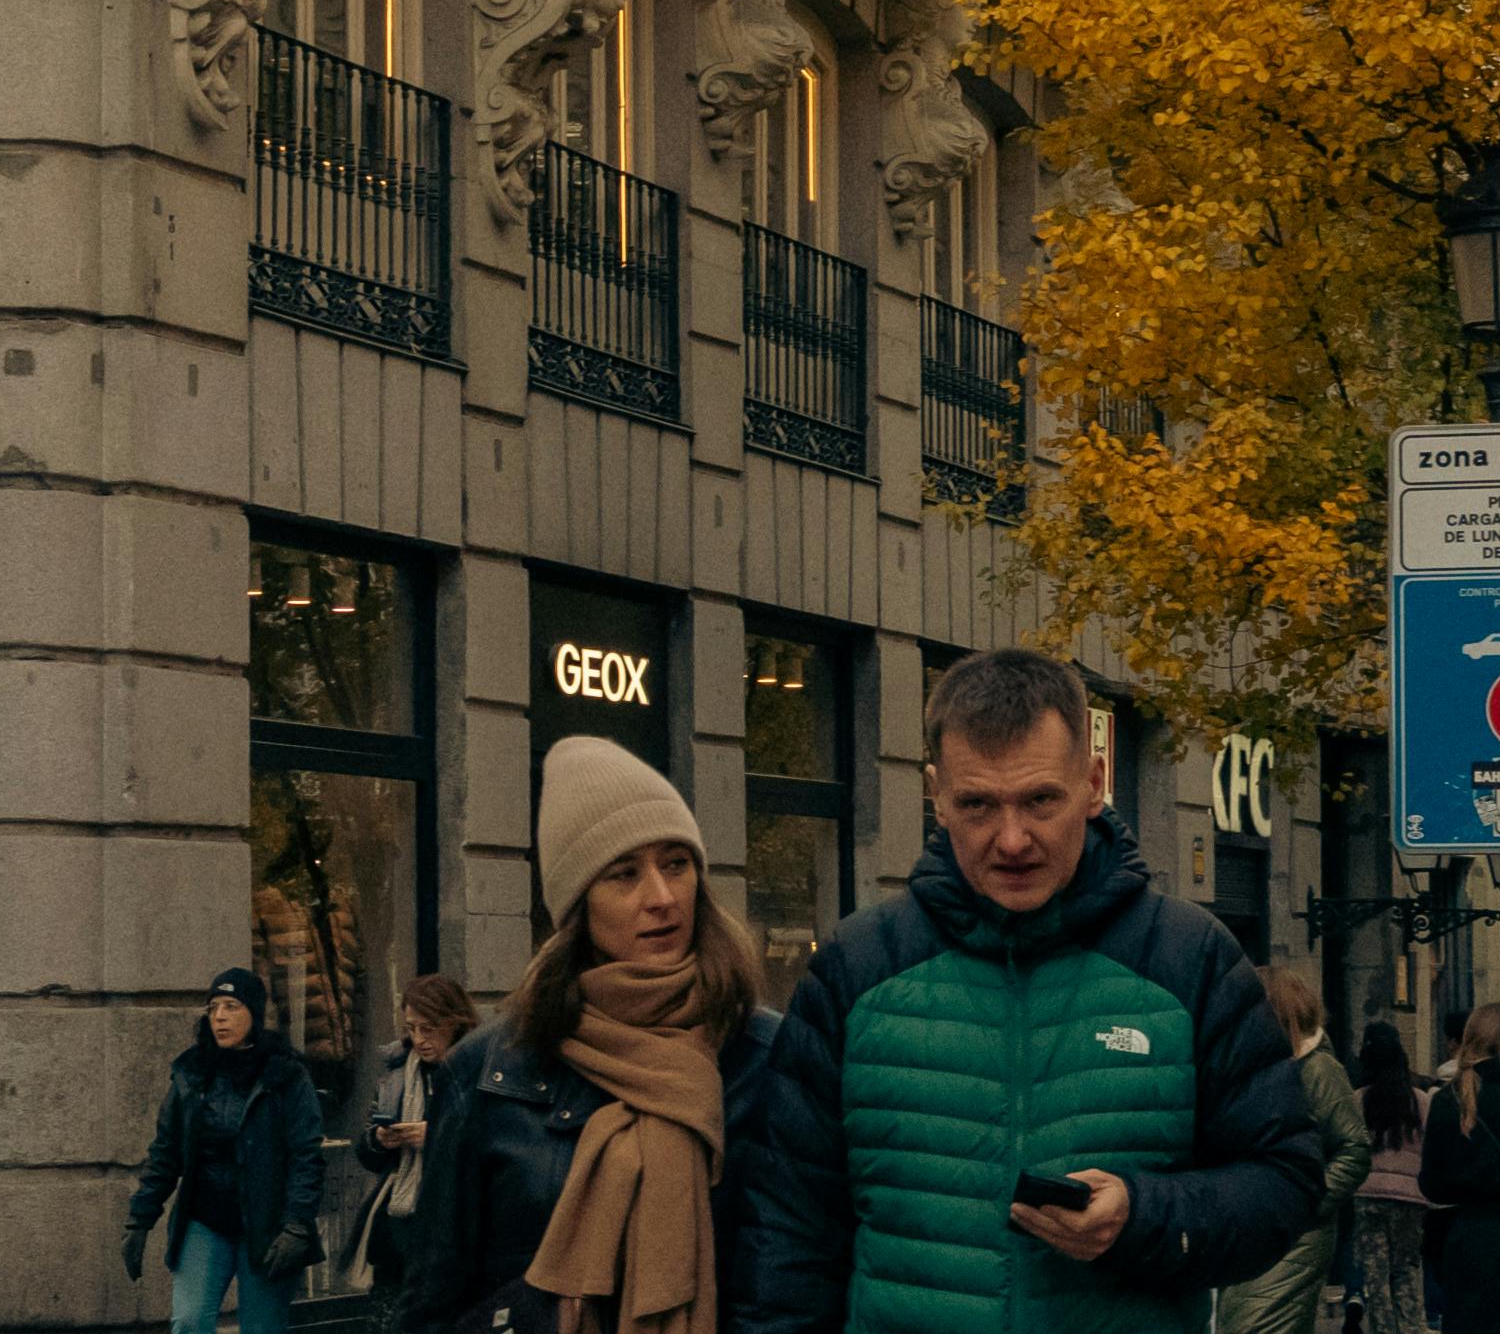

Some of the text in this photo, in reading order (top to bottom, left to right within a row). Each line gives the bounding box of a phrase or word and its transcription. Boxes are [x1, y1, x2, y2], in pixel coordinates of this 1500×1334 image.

[1419, 449, 1488, 468] zona
[1445, 531, 1465, 543] DE
[555, 643, 650, 705] GEOX
